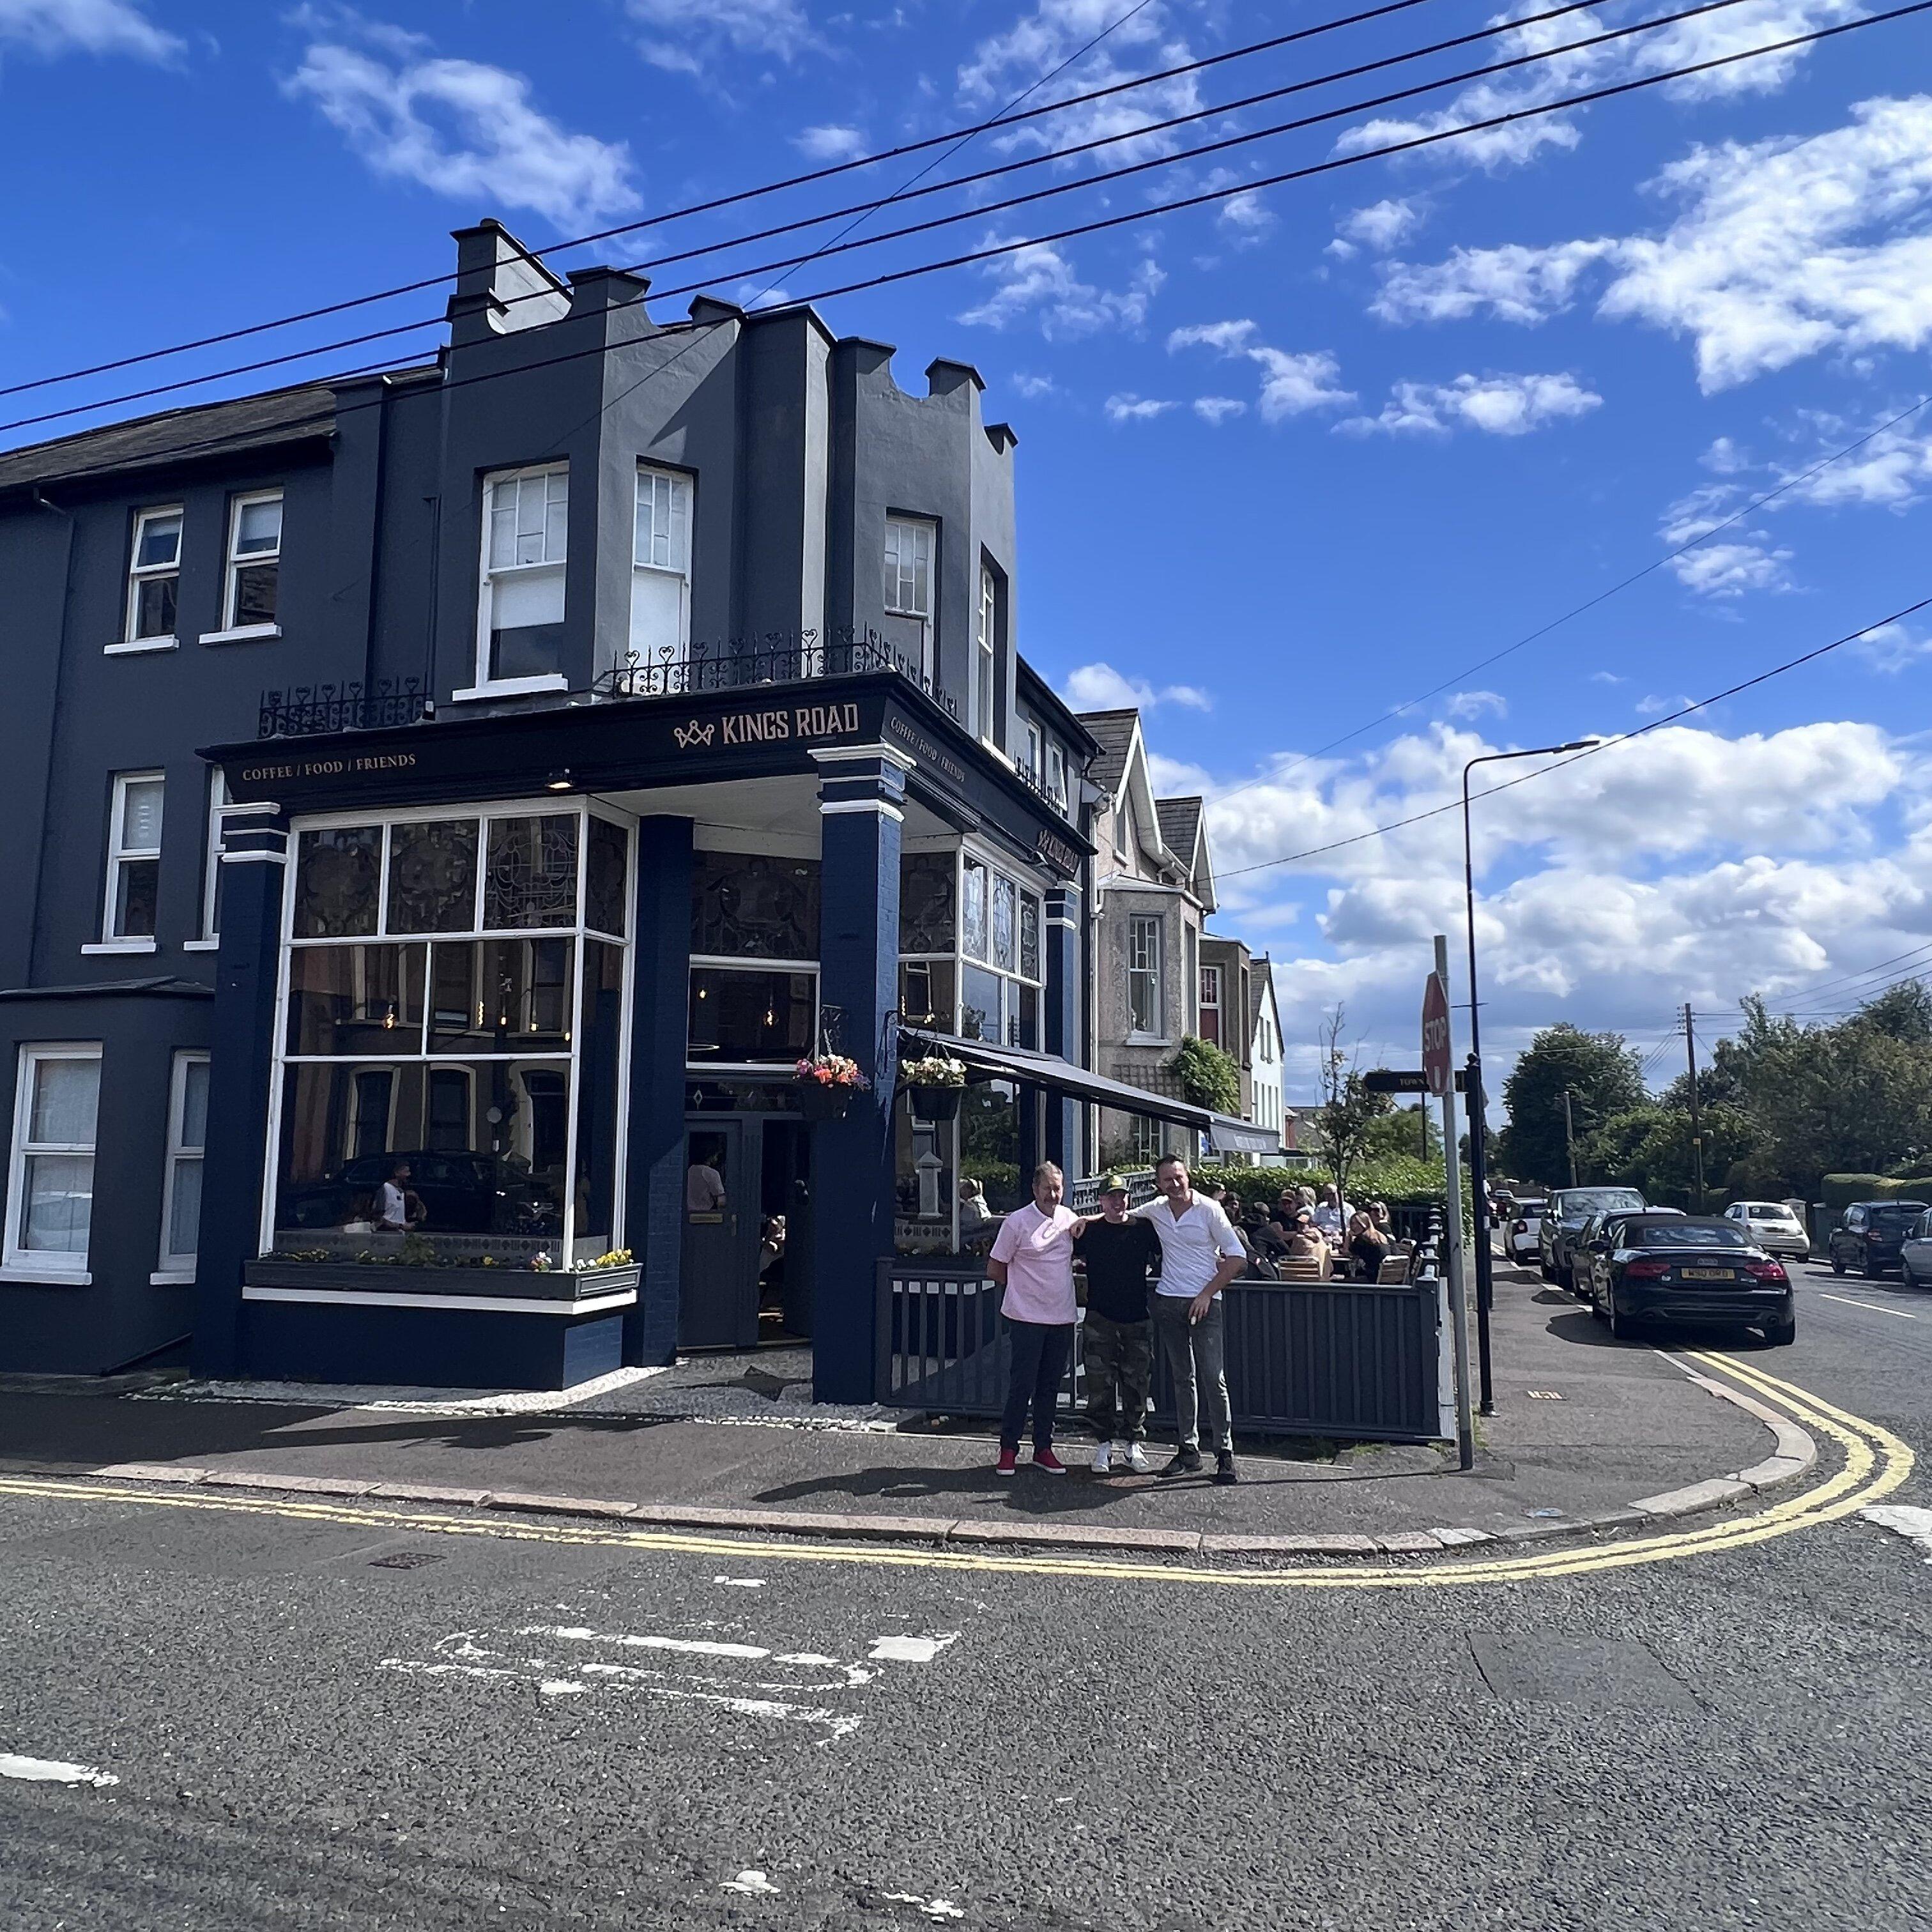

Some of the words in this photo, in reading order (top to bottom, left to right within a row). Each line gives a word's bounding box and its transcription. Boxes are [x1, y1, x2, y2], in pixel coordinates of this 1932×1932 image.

[721, 710, 789, 744] KINGS
[795, 703, 859, 737] ROAD
[242, 765, 293, 781] COFFEE
[304, 760, 343, 776] FOOD
[356, 753, 416, 770] FRIENDS
[891, 717, 917, 744] COFFEE
[919, 739, 938, 760] FOOD
[940, 756, 965, 782] FRIENDS
[1424, 1016, 1446, 1052] STOP
